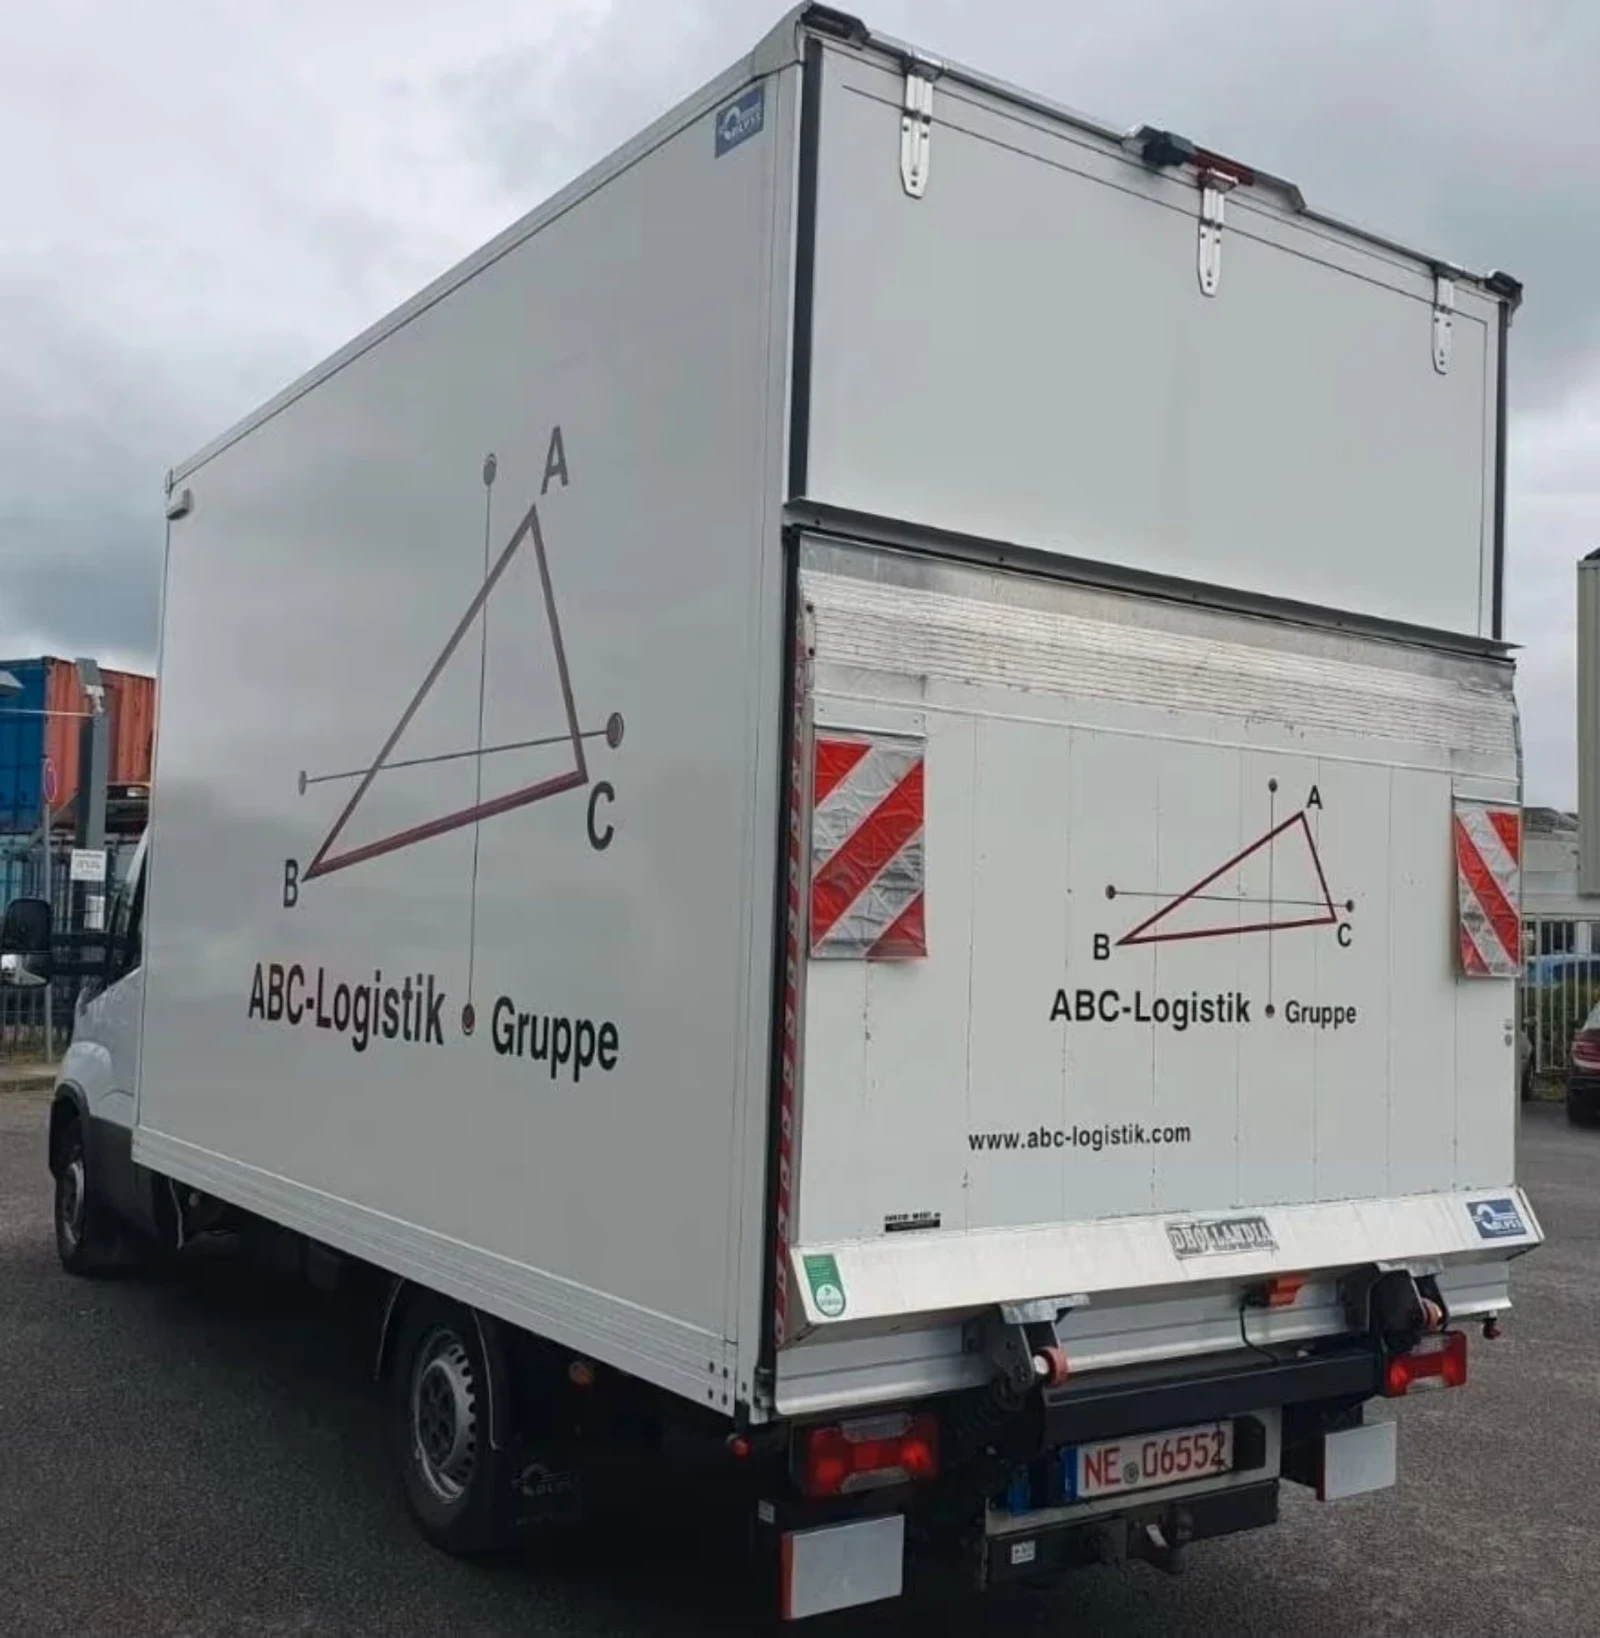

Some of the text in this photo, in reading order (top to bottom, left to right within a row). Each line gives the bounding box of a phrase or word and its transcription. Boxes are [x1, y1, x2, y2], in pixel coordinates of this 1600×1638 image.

[541, 425, 569, 495] A
[587, 781, 615, 851] C
[1306, 785, 1323, 809] A
[283, 859, 299, 908] B
[1093, 933, 1110, 960] B
[1337, 922, 1352, 947] C
[248, 962, 619, 1082] ABC-Logistik Gruppe
[1050, 988, 1357, 1031] ABC-Logistik Gruppe
[968, 1124, 1191, 1151] www.abc-logistik.com
[1084, 1447, 1121, 1489] NE
